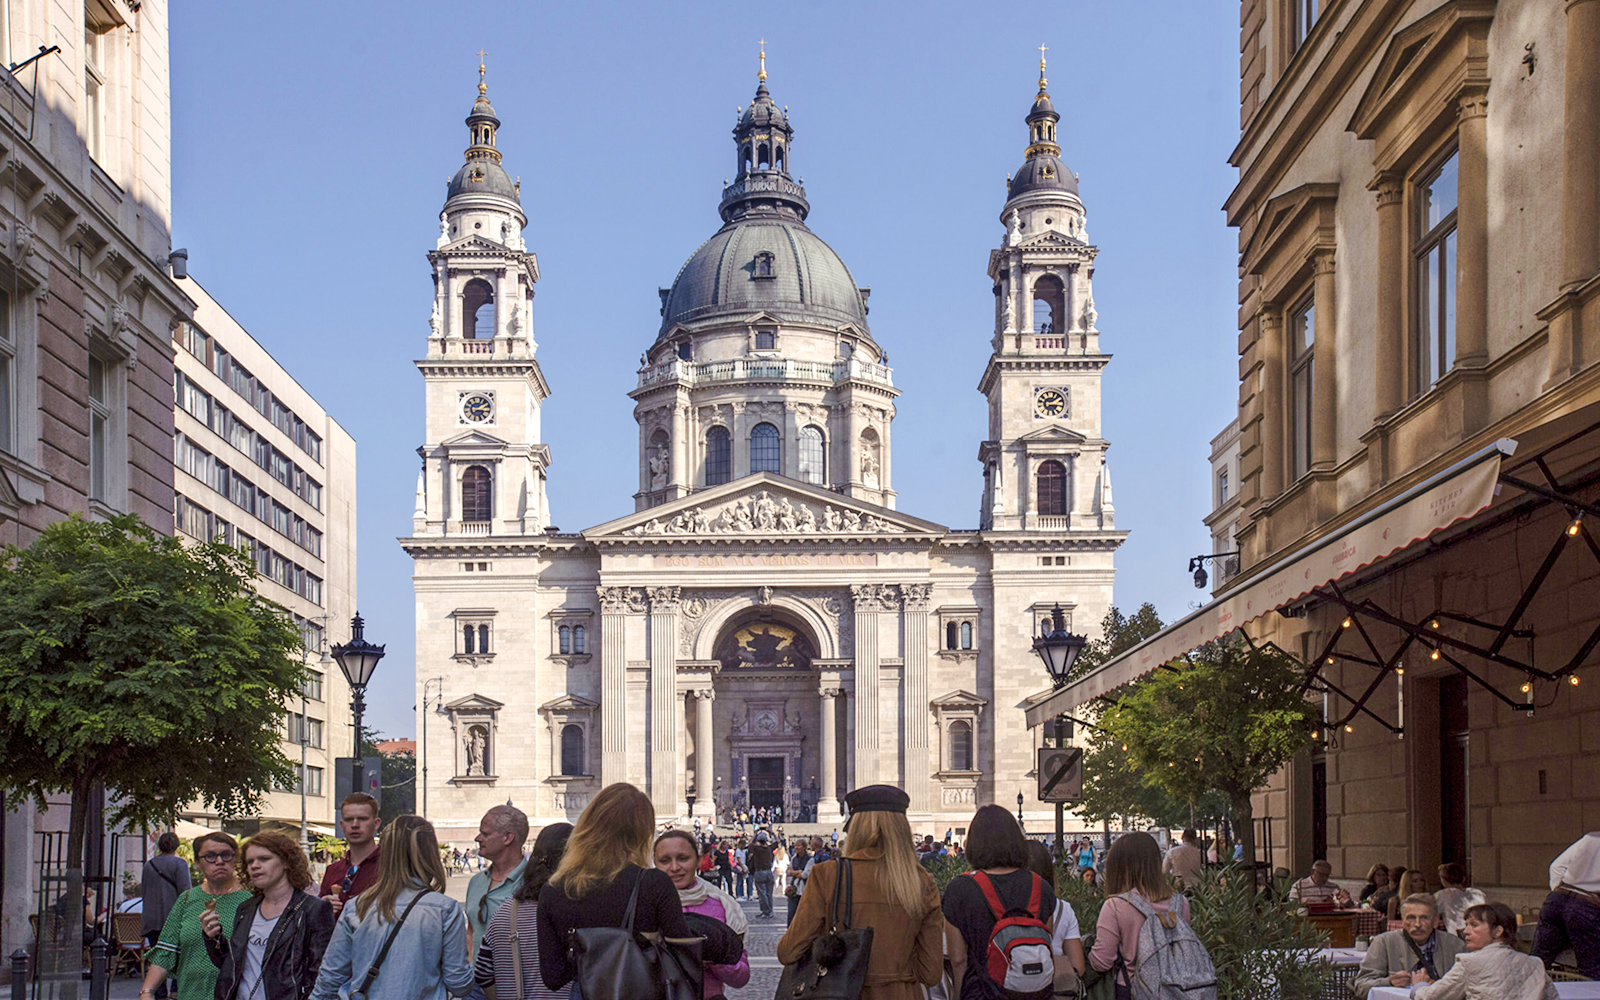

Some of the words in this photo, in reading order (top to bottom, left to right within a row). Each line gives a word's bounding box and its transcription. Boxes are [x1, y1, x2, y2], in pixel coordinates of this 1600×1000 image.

[1429, 487, 1464, 510] KITCHEN
[1441, 500, 1456, 513] BAR
[666, 556, 691, 567] EGO
[698, 556, 725, 567] SUM
[733, 556, 755, 567] VIA
[761, 555, 811, 567] VERITAS
[817, 555, 832, 566] ET
[839, 555, 865, 566] VITA
